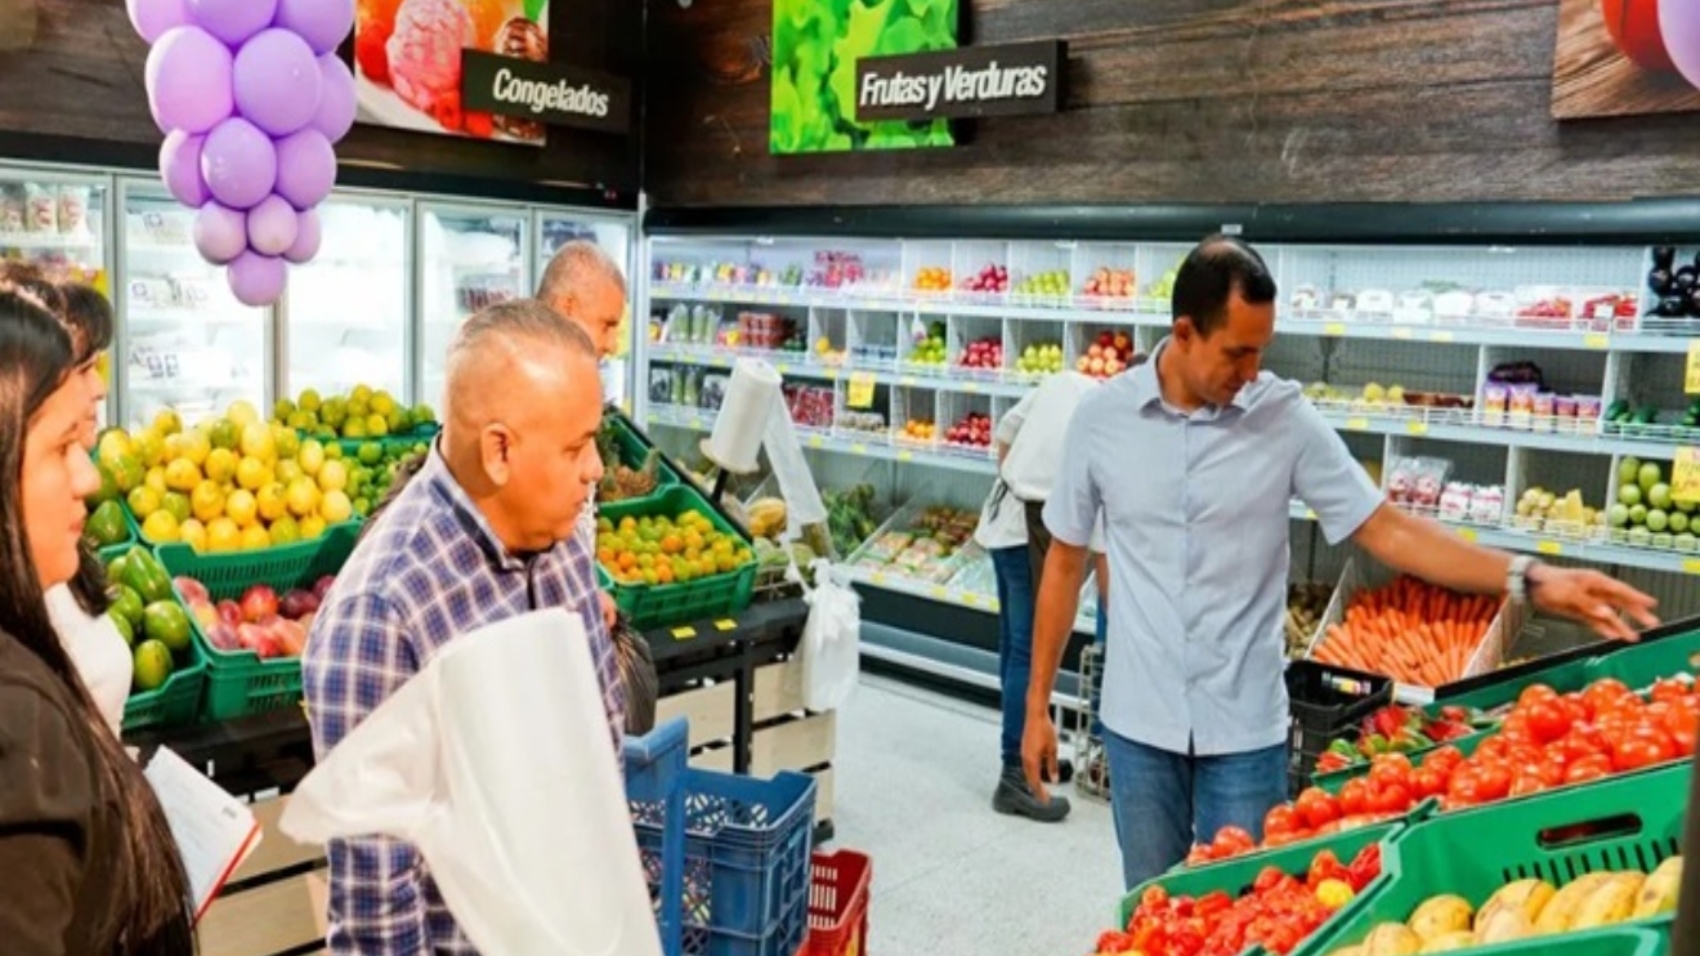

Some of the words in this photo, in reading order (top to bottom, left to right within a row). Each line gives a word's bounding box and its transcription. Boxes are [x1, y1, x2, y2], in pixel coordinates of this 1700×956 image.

[492, 67, 610, 118] Congelados
[860, 71, 926, 107] Frutas
[925, 74, 943, 111] y
[944, 60, 1048, 101] Verduras
